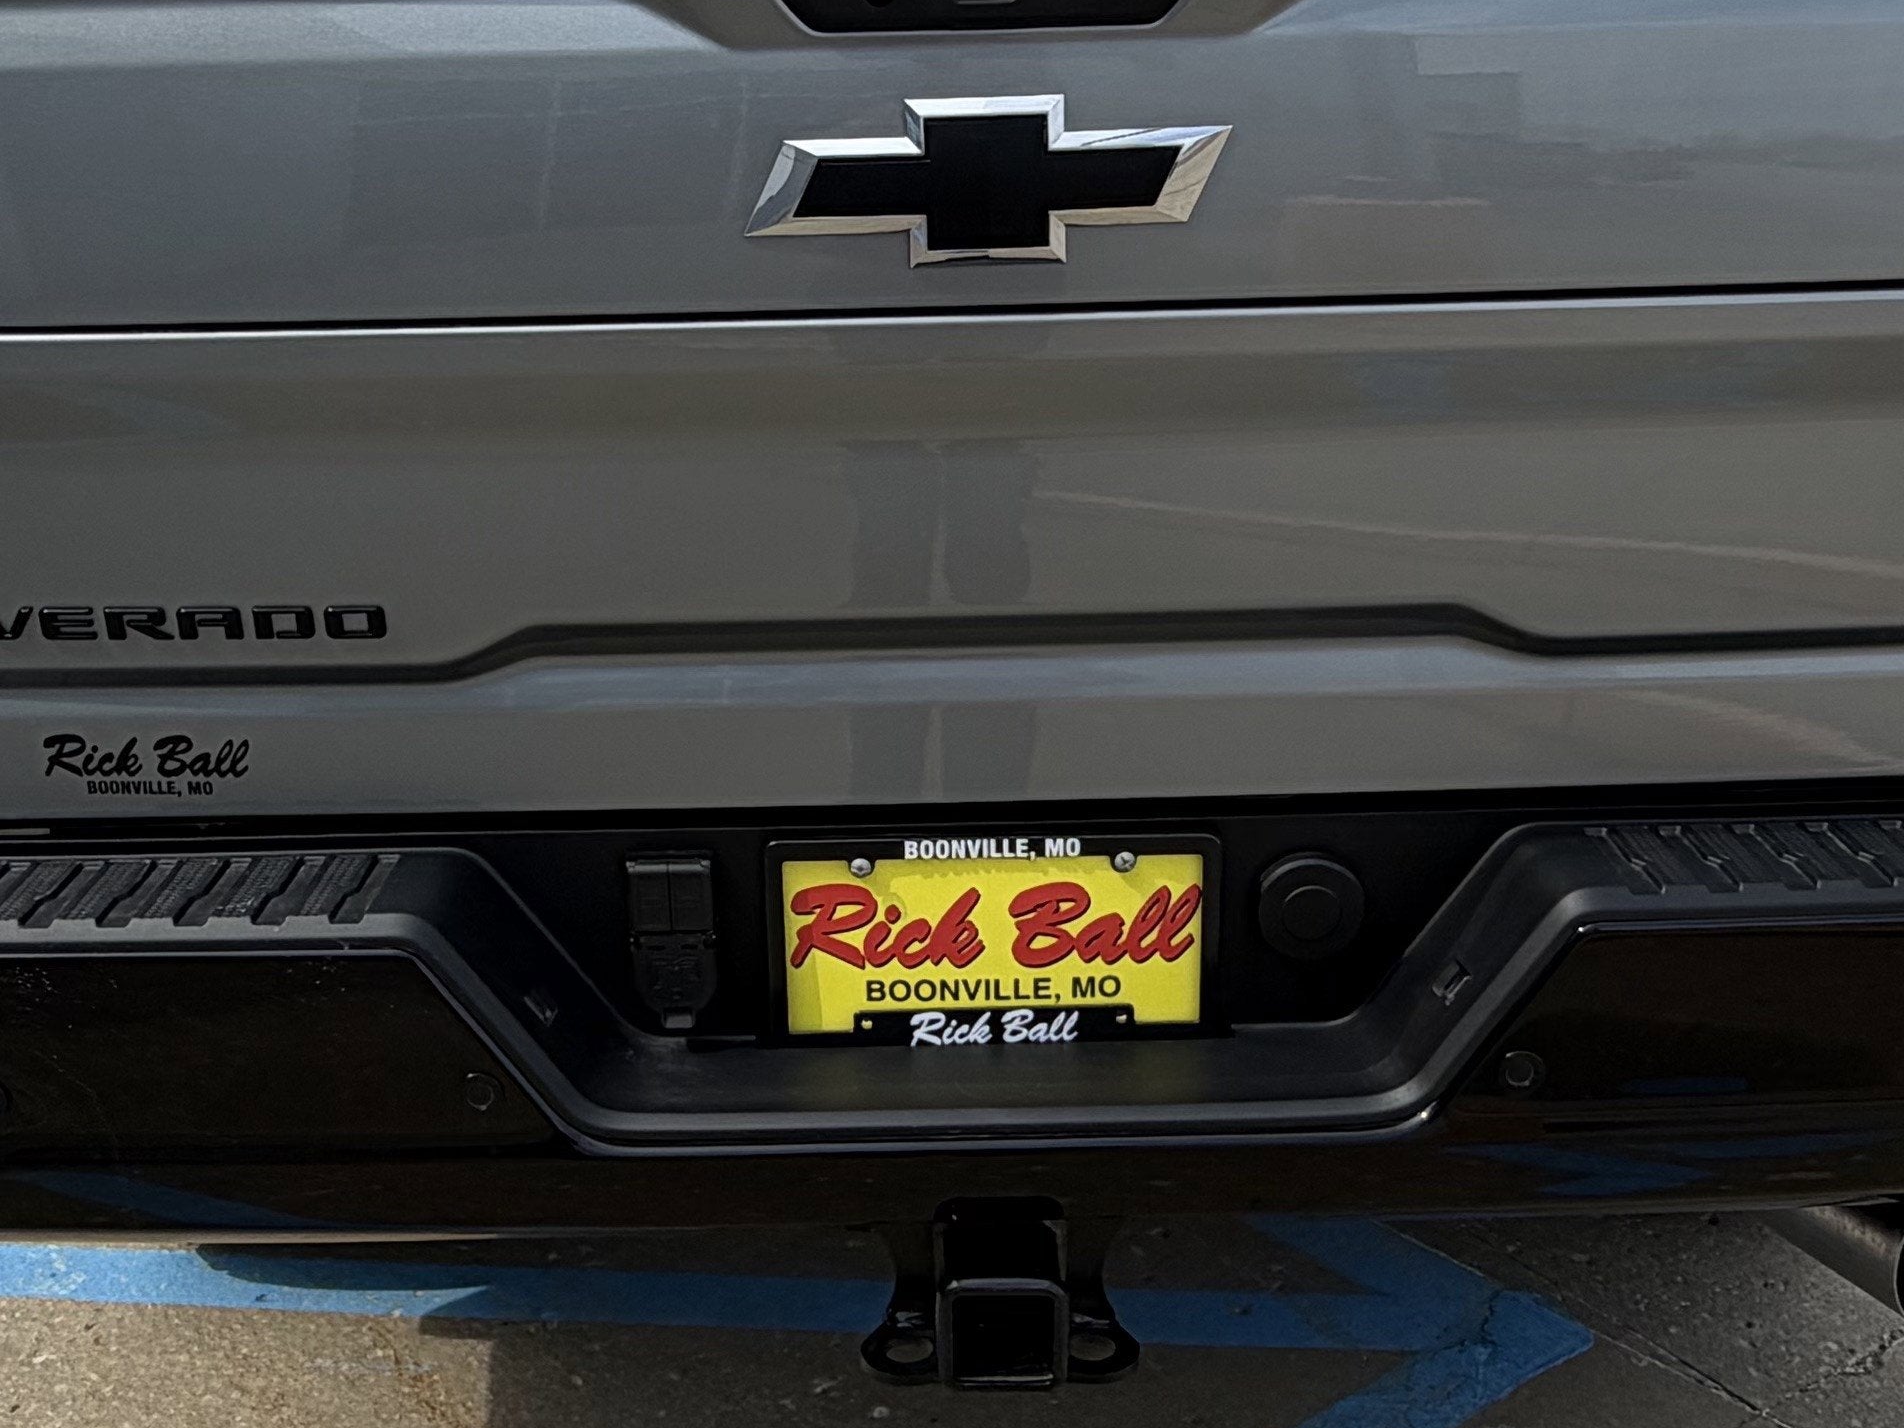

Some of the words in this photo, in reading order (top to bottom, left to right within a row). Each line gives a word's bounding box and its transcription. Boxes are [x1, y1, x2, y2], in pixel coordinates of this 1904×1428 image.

[42, 732, 144, 778] Rick
[152, 733, 251, 779] Ball
[86, 780, 183, 798] BOONVILLE,
[187, 780, 214, 797] MO
[903, 839, 1037, 861] BOONVILLE,
[1043, 837, 1082, 858] MO
[790, 882, 985, 970] Rick
[1008, 881, 1203, 968] Ball
[864, 976, 1062, 1004] BOONVILLE,
[1071, 975, 1122, 999] MO
[909, 1012, 993, 1048] Rick
[1001, 1009, 1080, 1044] Ball
